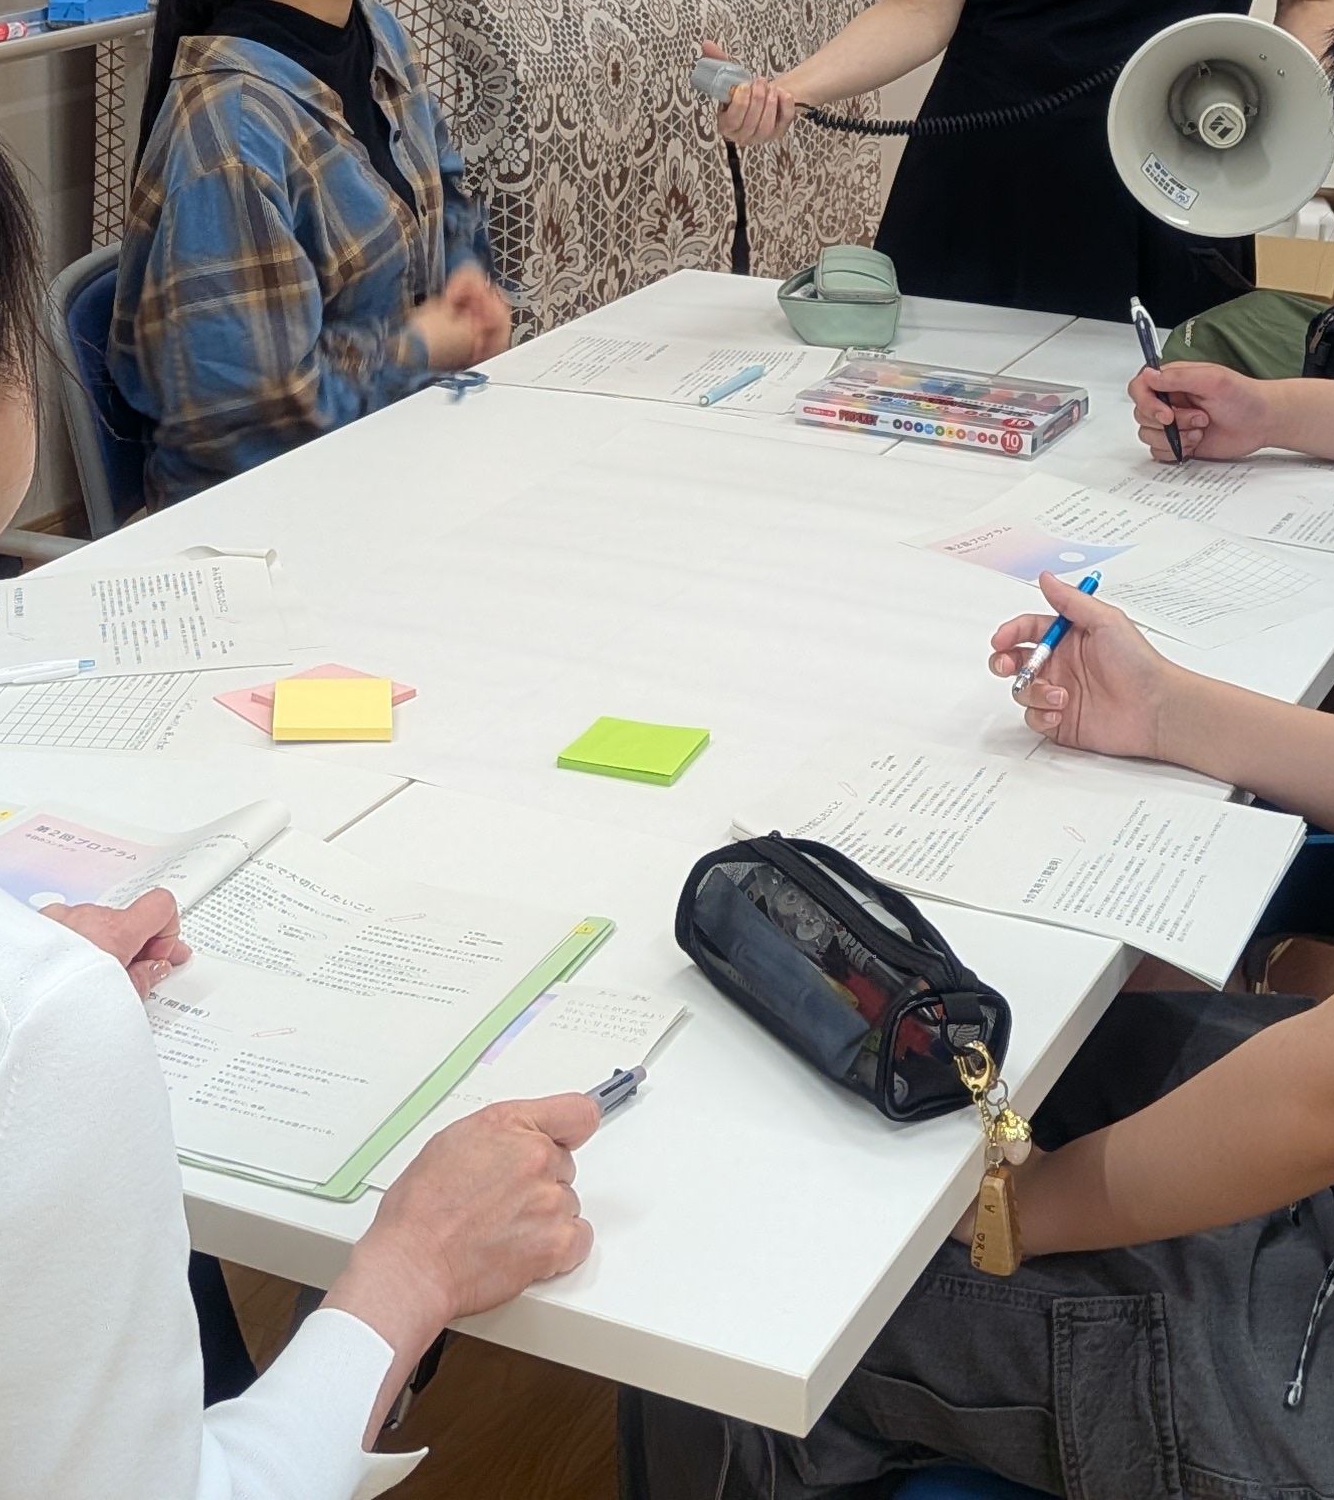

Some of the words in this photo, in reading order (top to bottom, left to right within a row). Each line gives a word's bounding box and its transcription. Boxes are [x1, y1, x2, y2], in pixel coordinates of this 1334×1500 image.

[1004, 434, 1019, 447] 10
[34, 824, 139, 862] 第2回プログラム
